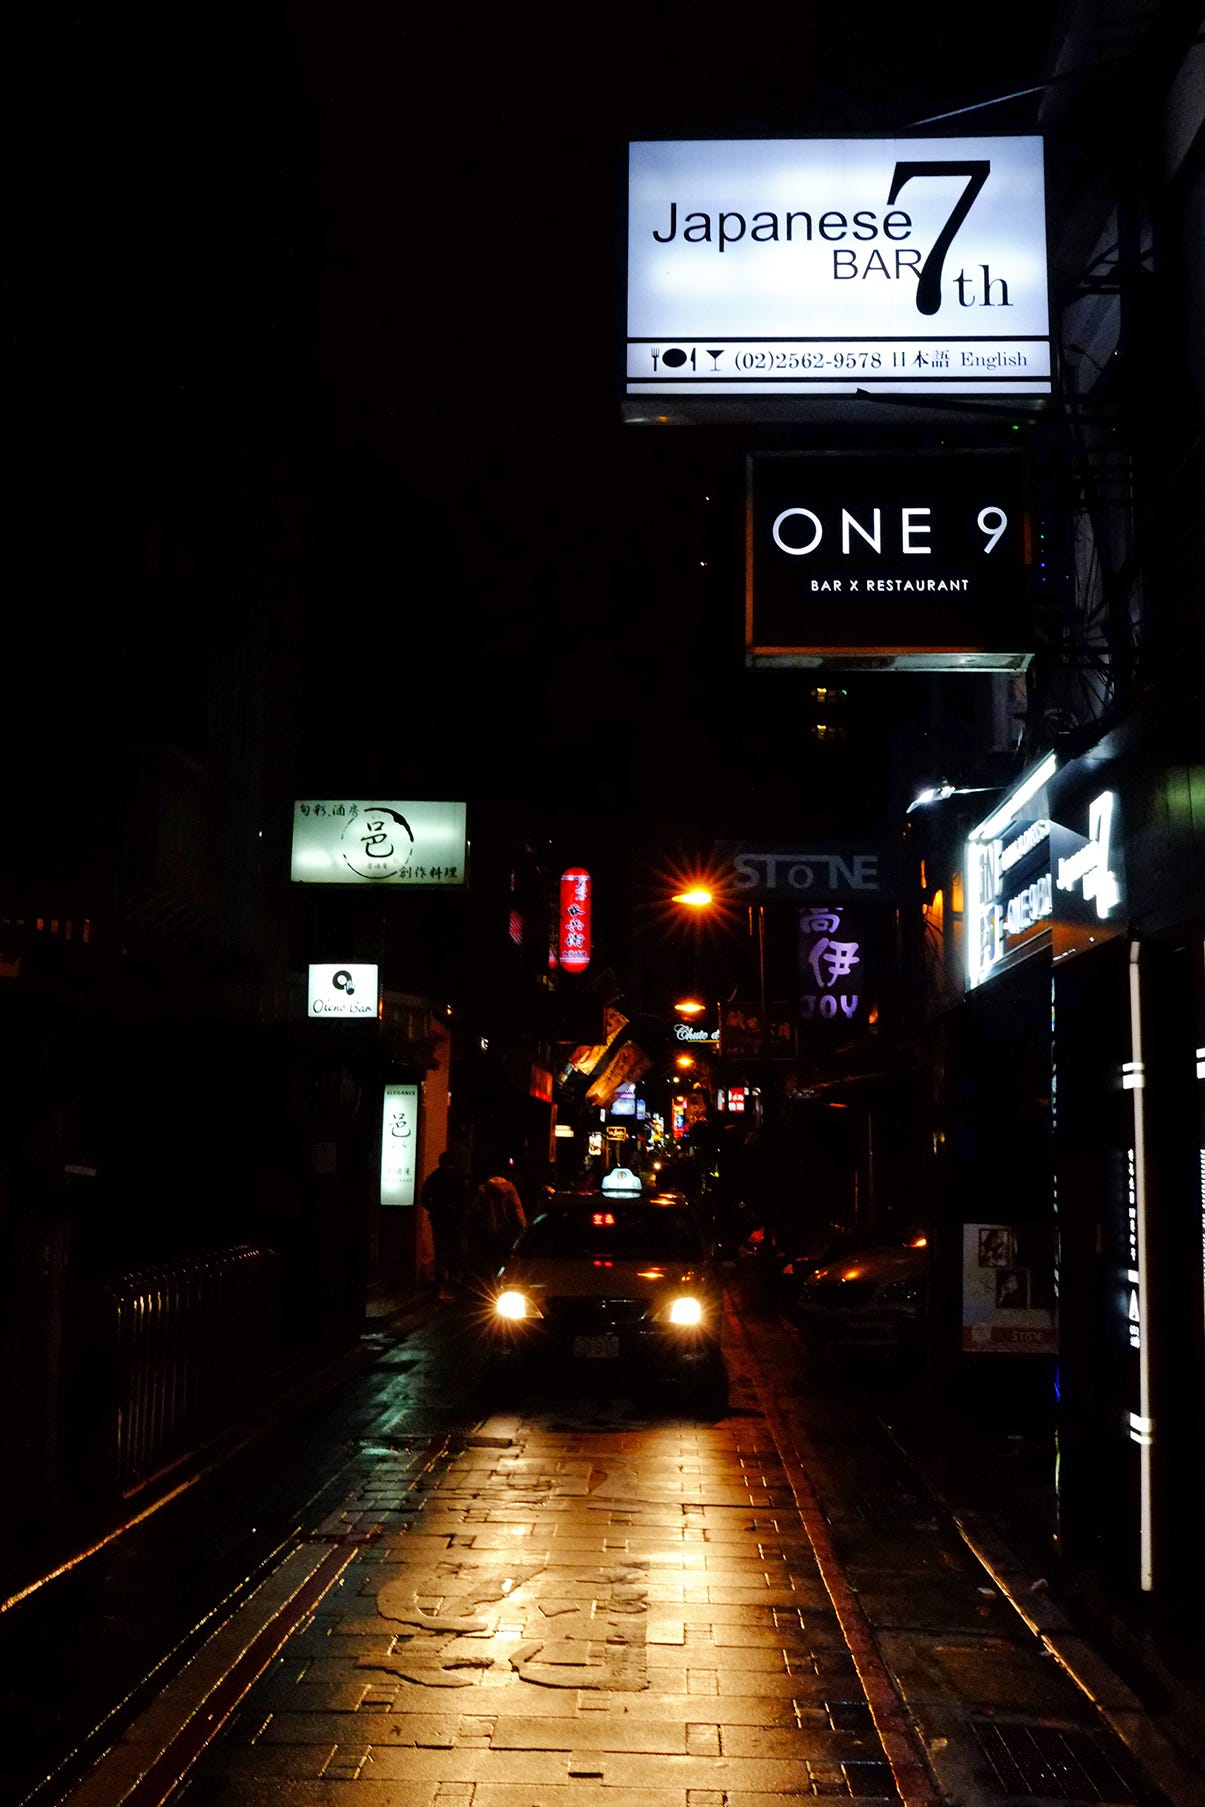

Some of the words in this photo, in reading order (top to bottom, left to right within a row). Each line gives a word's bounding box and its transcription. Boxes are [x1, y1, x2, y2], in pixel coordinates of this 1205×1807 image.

[652, 203, 912, 252] Japanese
[833, 249, 922, 280] BAR
[734, 351, 882, 371] (02)2562-9578
[961, 351, 1027, 370] English
[772, 507, 932, 556] ONE
[977, 506, 1008, 554] 9
[811, 580, 842, 592] BAR
[849, 580, 859, 592] X
[867, 579, 969, 592] RESTAURANT
[800, 995, 859, 1019] JOY
